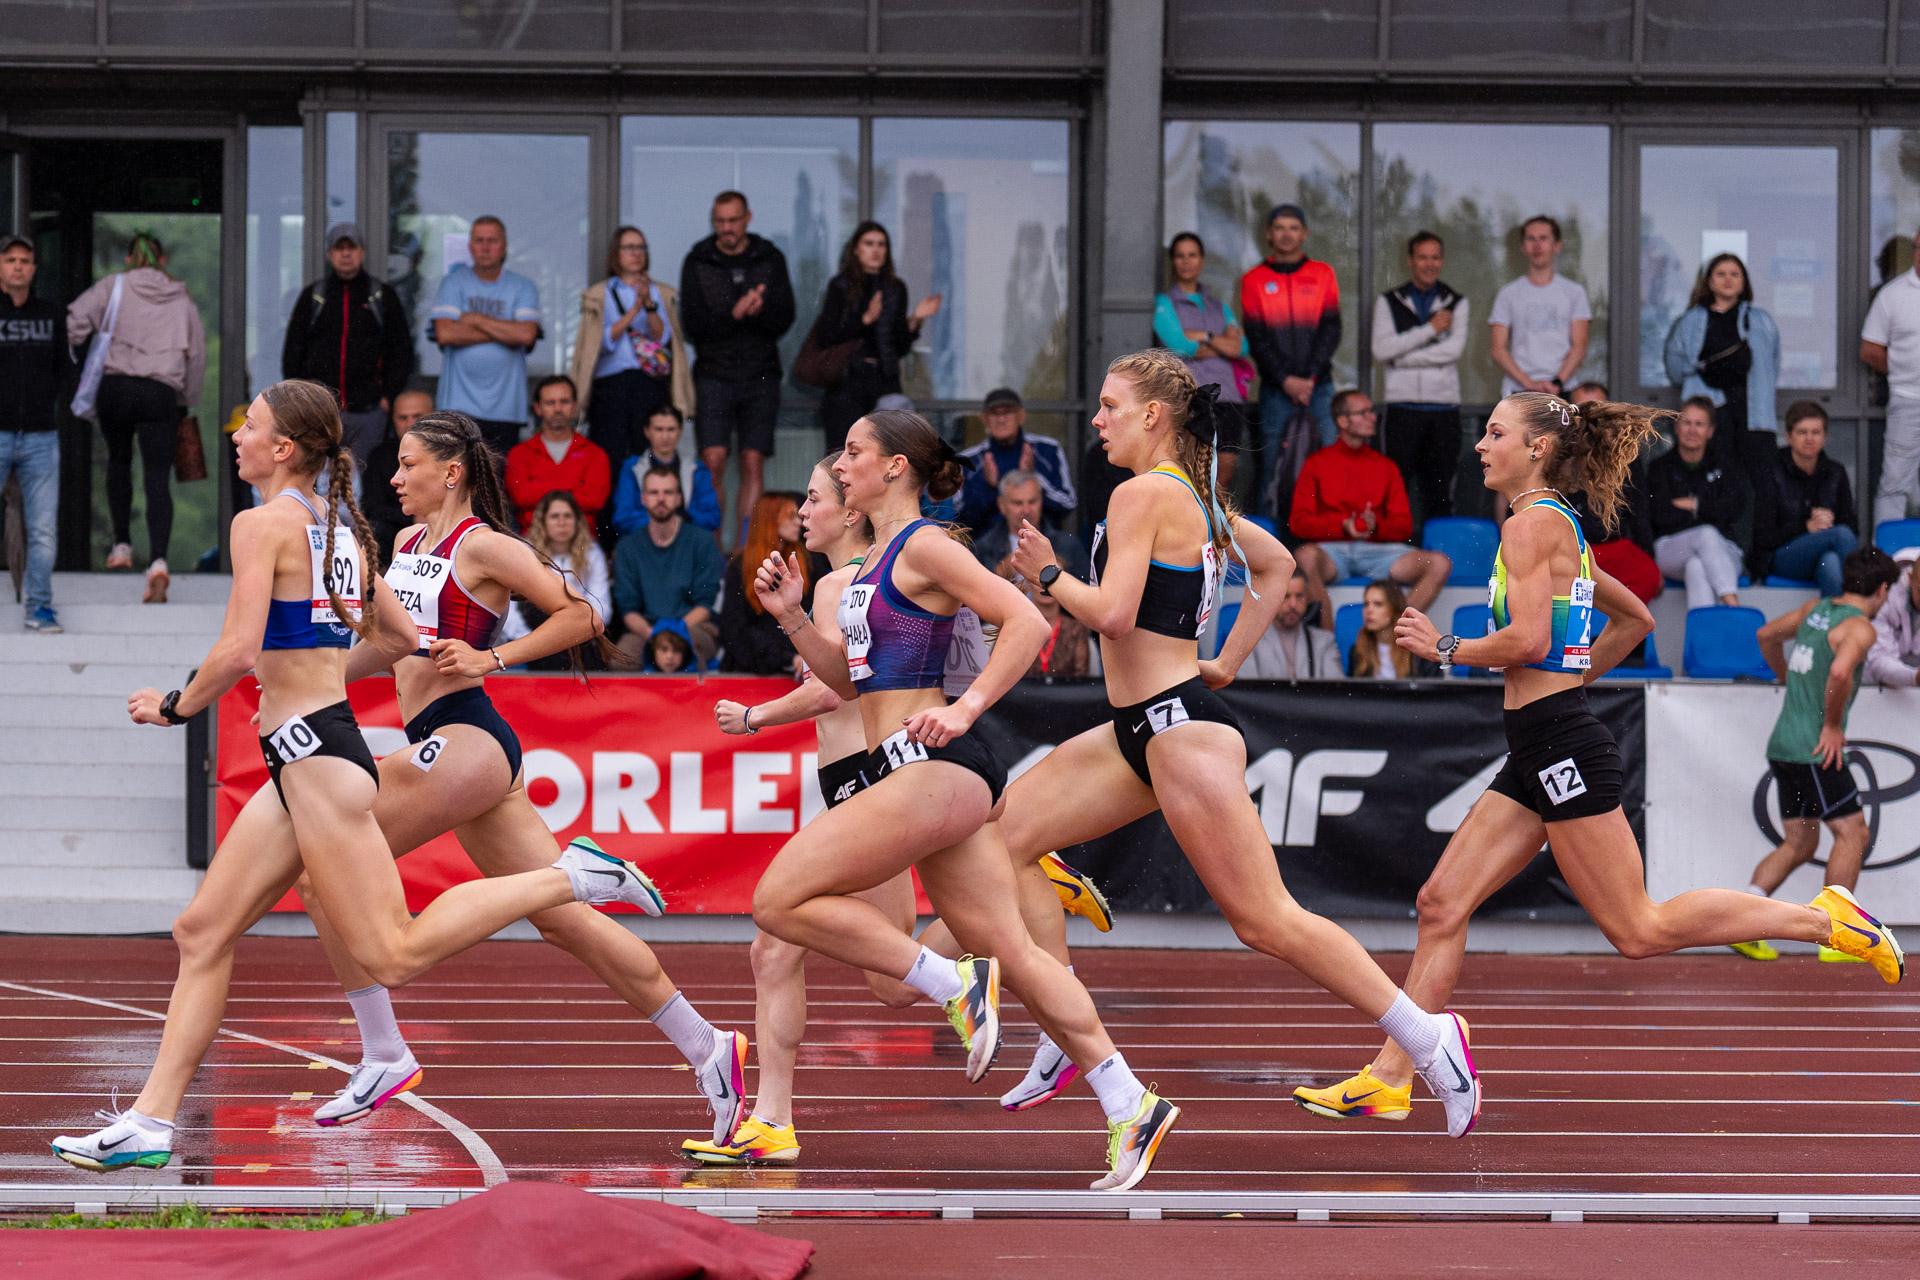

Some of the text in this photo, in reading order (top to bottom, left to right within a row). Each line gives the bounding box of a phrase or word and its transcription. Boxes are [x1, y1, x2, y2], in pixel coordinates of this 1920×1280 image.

[413, 559, 442, 578] 309
[849, 590, 866, 609] 270
[1153, 703, 1174, 727] 7
[279, 724, 313, 759] 10
[419, 740, 441, 764] 6
[890, 738, 921, 765] 11
[1544, 766, 1582, 797] 12
